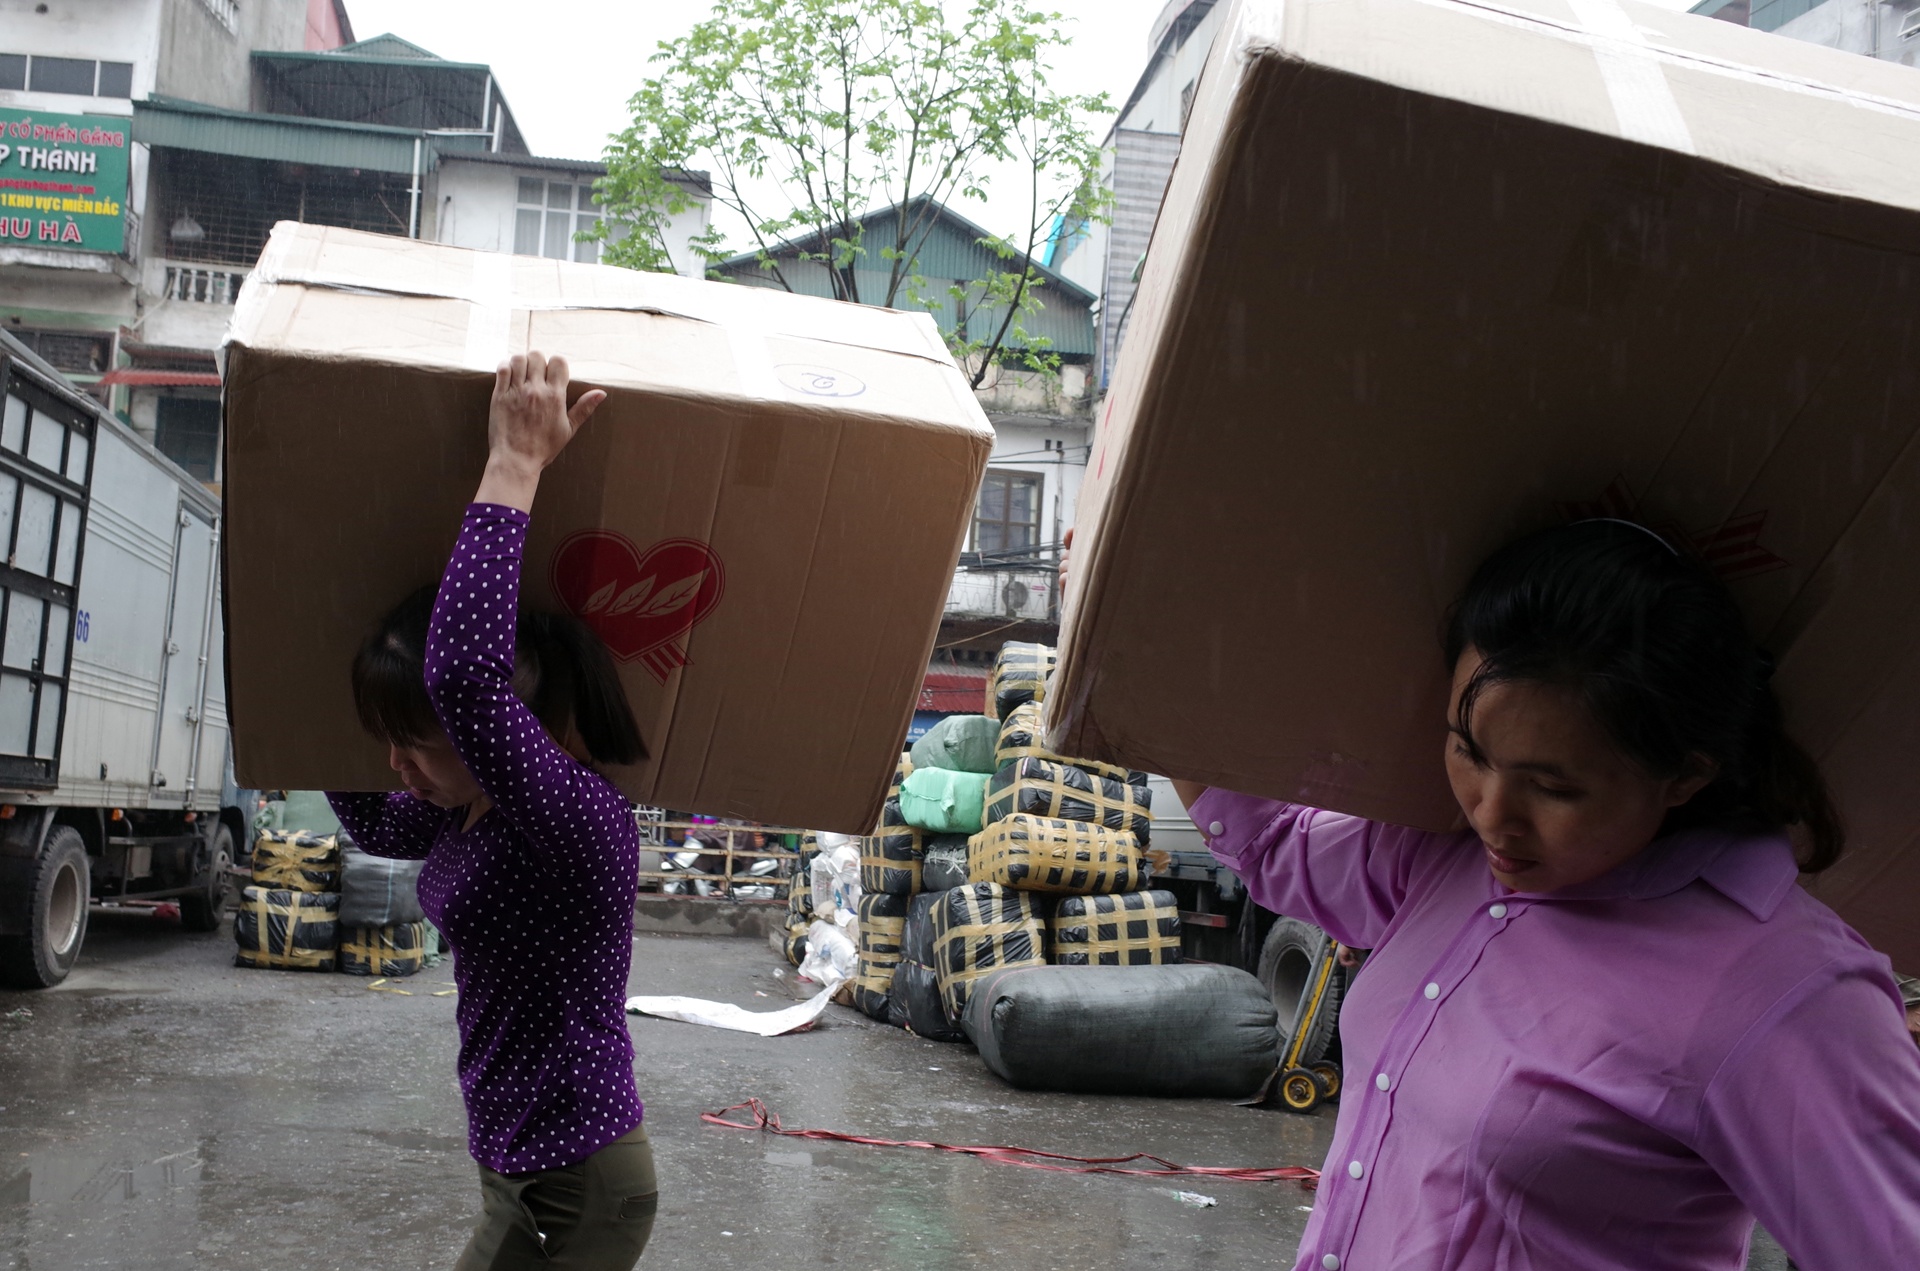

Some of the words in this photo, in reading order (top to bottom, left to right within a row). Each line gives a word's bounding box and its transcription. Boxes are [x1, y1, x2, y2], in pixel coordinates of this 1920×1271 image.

[17, 142, 96, 174] THÀNH
[8, 193, 34, 209] KHU
[35, 195, 61, 214] VỰC
[94, 195, 120, 217] BẮC
[39, 215, 83, 243] HÀ
[76, 609, 90, 643] 66
